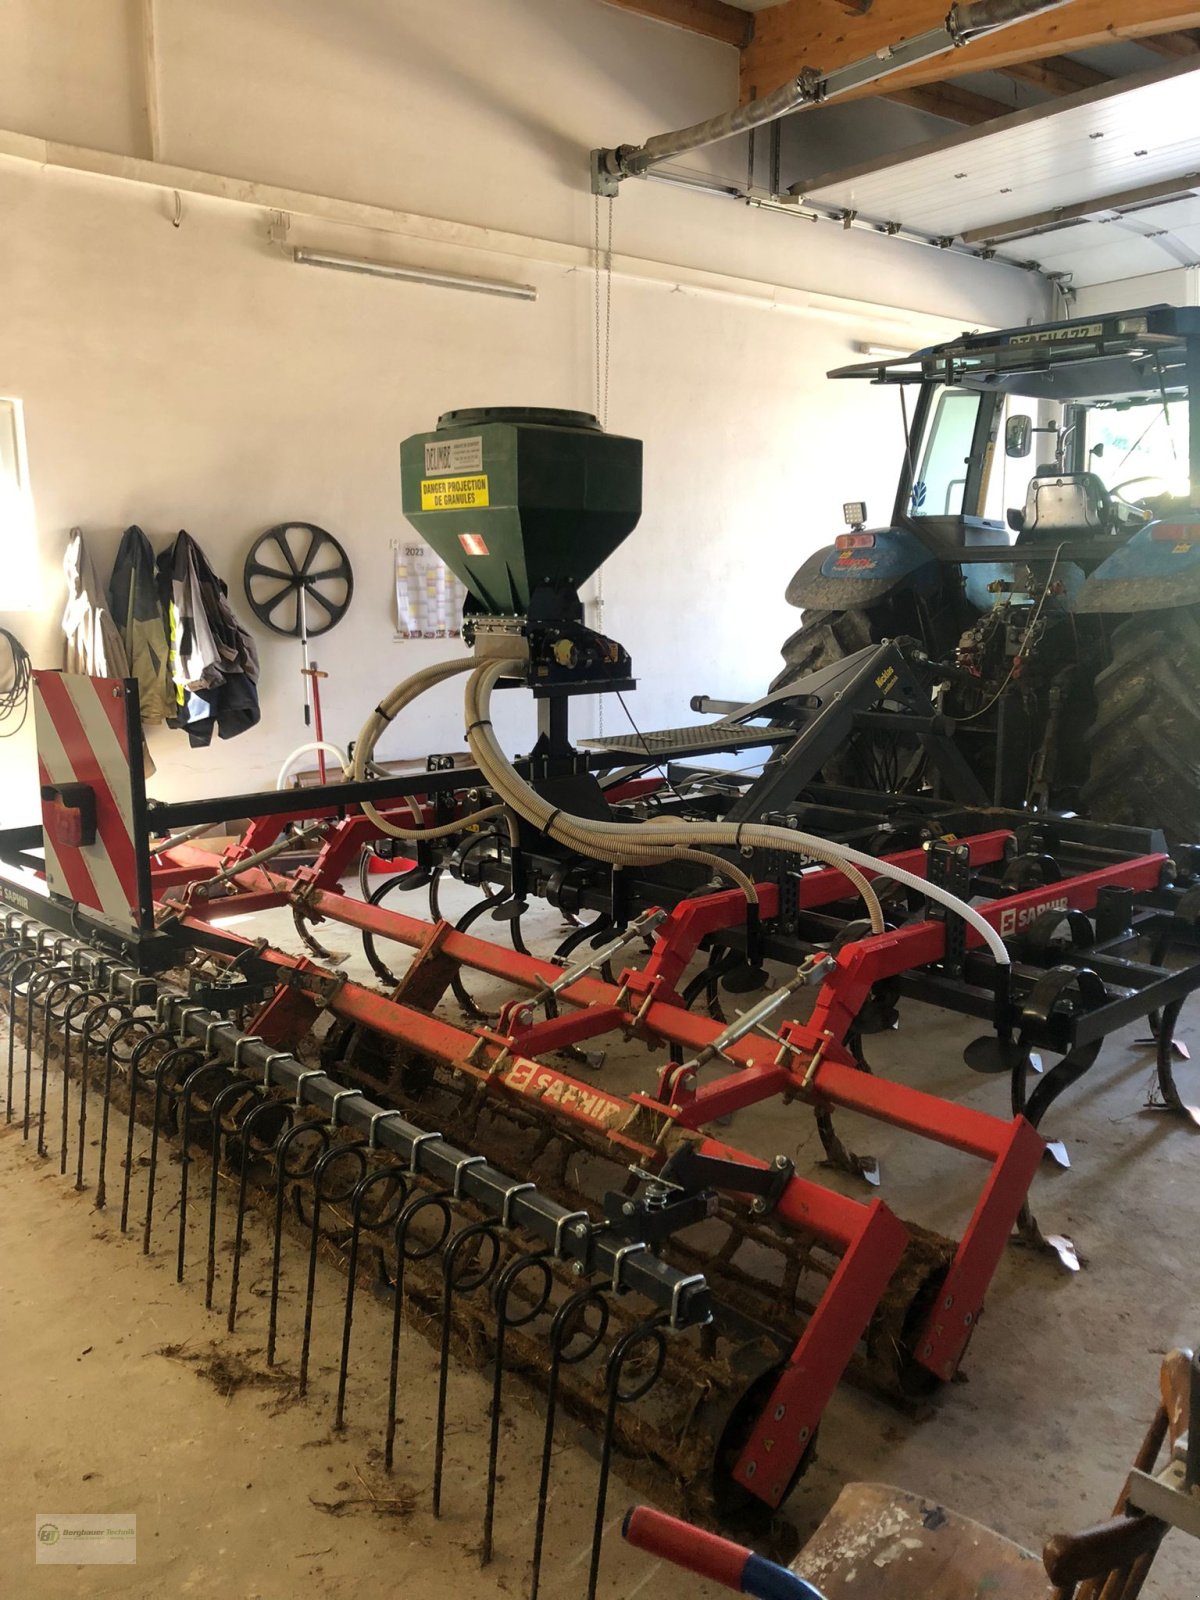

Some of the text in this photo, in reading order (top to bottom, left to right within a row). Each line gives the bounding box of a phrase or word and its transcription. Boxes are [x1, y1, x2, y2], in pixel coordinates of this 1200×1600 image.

[427, 446, 450, 471] DELIMBE
[423, 479, 486, 494] DANGER PROJECTION
[434, 493, 475, 506] DE GRANULES
[405, 548, 424, 556] 2023
[5, 888, 29, 910] SAPHIR
[534, 1074, 620, 1121] SAPHIR
